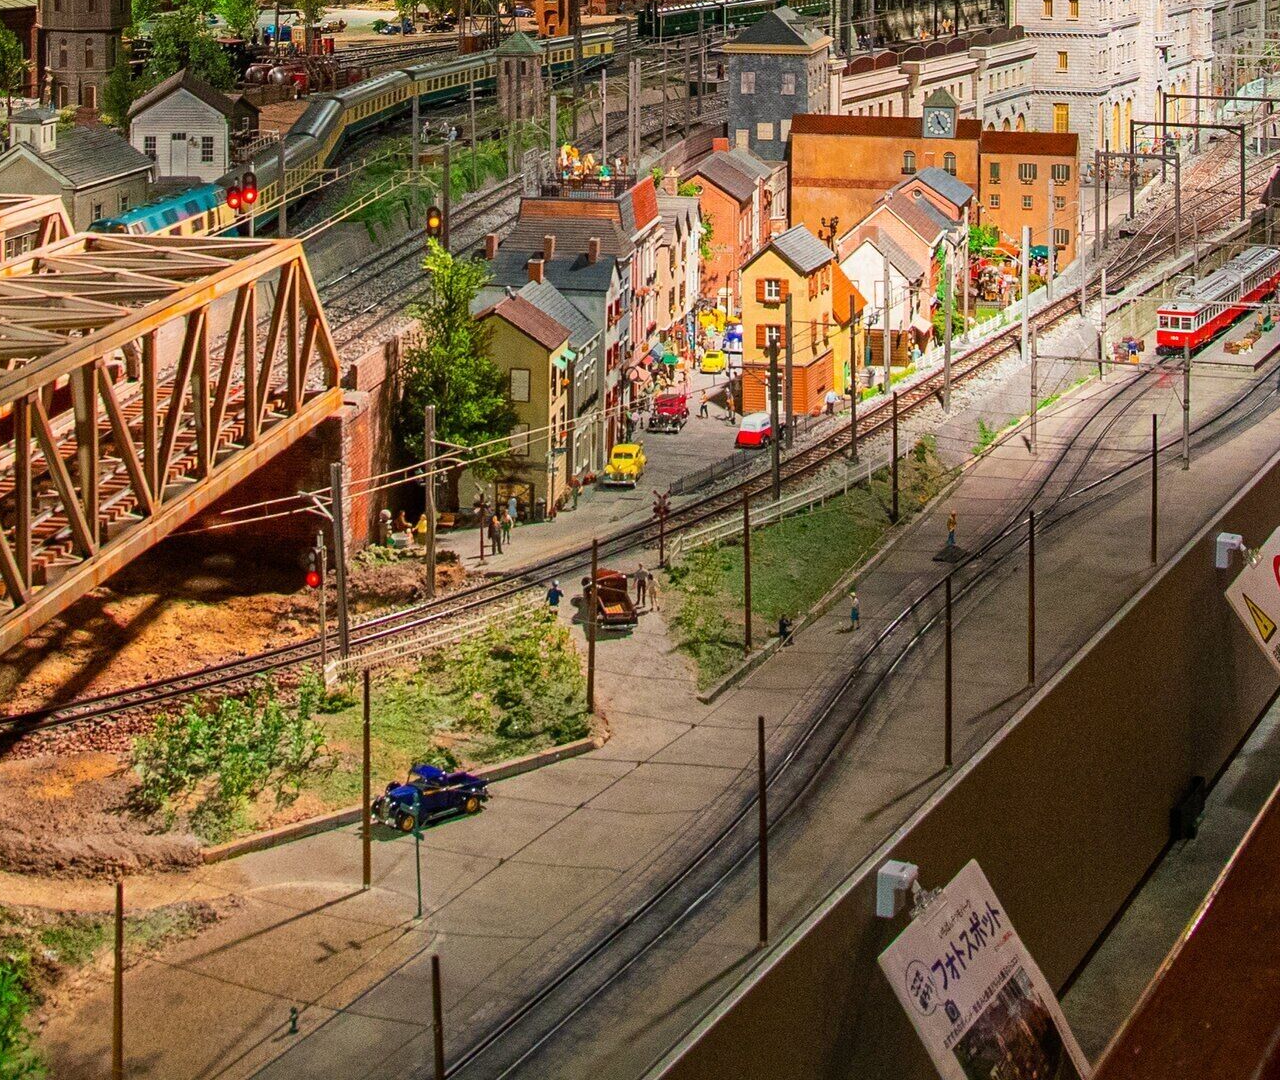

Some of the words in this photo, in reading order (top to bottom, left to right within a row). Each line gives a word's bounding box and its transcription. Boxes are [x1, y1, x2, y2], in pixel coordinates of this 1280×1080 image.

[931, 901, 1001, 990] フォトスポット
[909, 969, 925, 998] ここで
